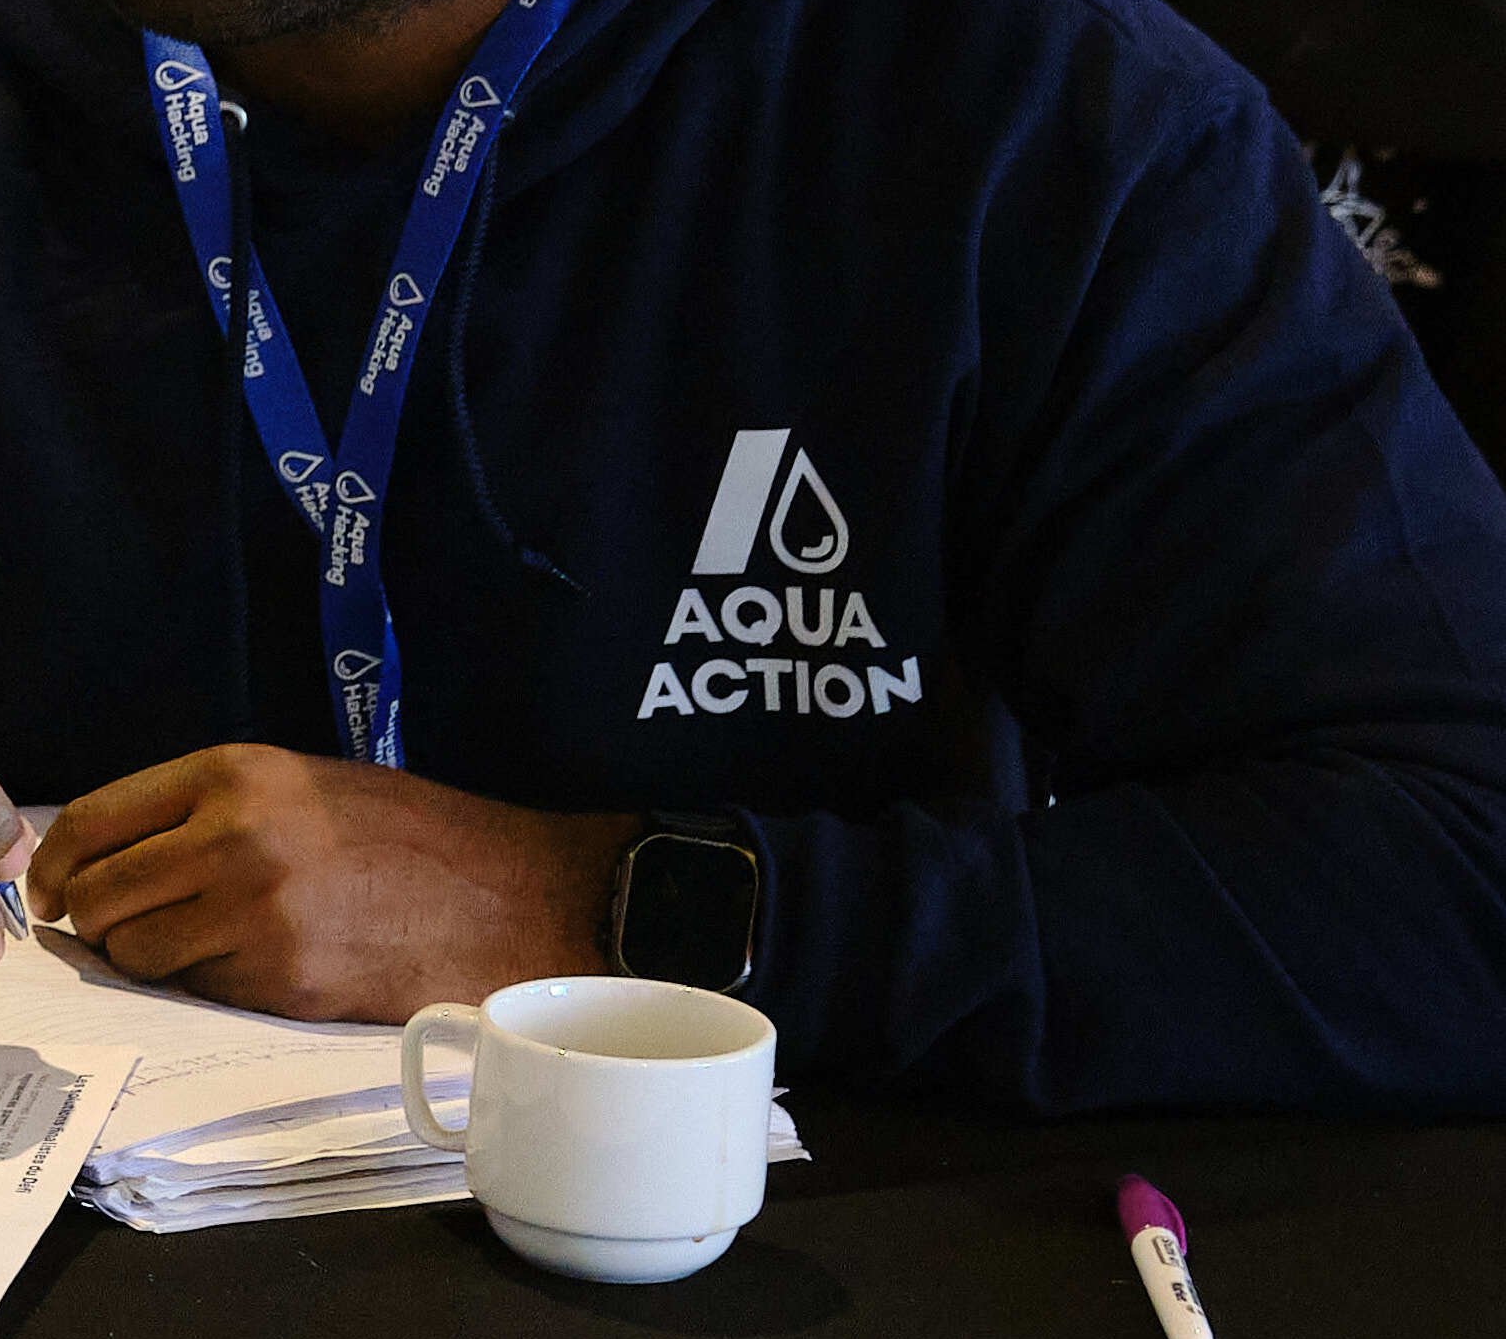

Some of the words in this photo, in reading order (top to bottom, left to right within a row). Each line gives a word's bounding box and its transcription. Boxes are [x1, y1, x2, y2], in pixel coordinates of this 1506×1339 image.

[164, 93, 196, 182] Hacking
[187, 90, 208, 146] Aqua
[454, 115, 485, 173] Aqua
[424, 109, 469, 197] Hacking
[360, 307, 396, 396] Hacking
[385, 312, 413, 372] Aqua
[325, 504, 353, 587] Hacking
[350, 511, 371, 567] Aqua
[663, 586, 888, 648] AQUA
[637, 656, 923, 720] ACTION
[51, 1088, 83, 1126] solutions
[73, 1073, 94, 1087] Les
[30, 1126, 65, 1164] finalistes
[14, 1177, 38, 1194] Défi
